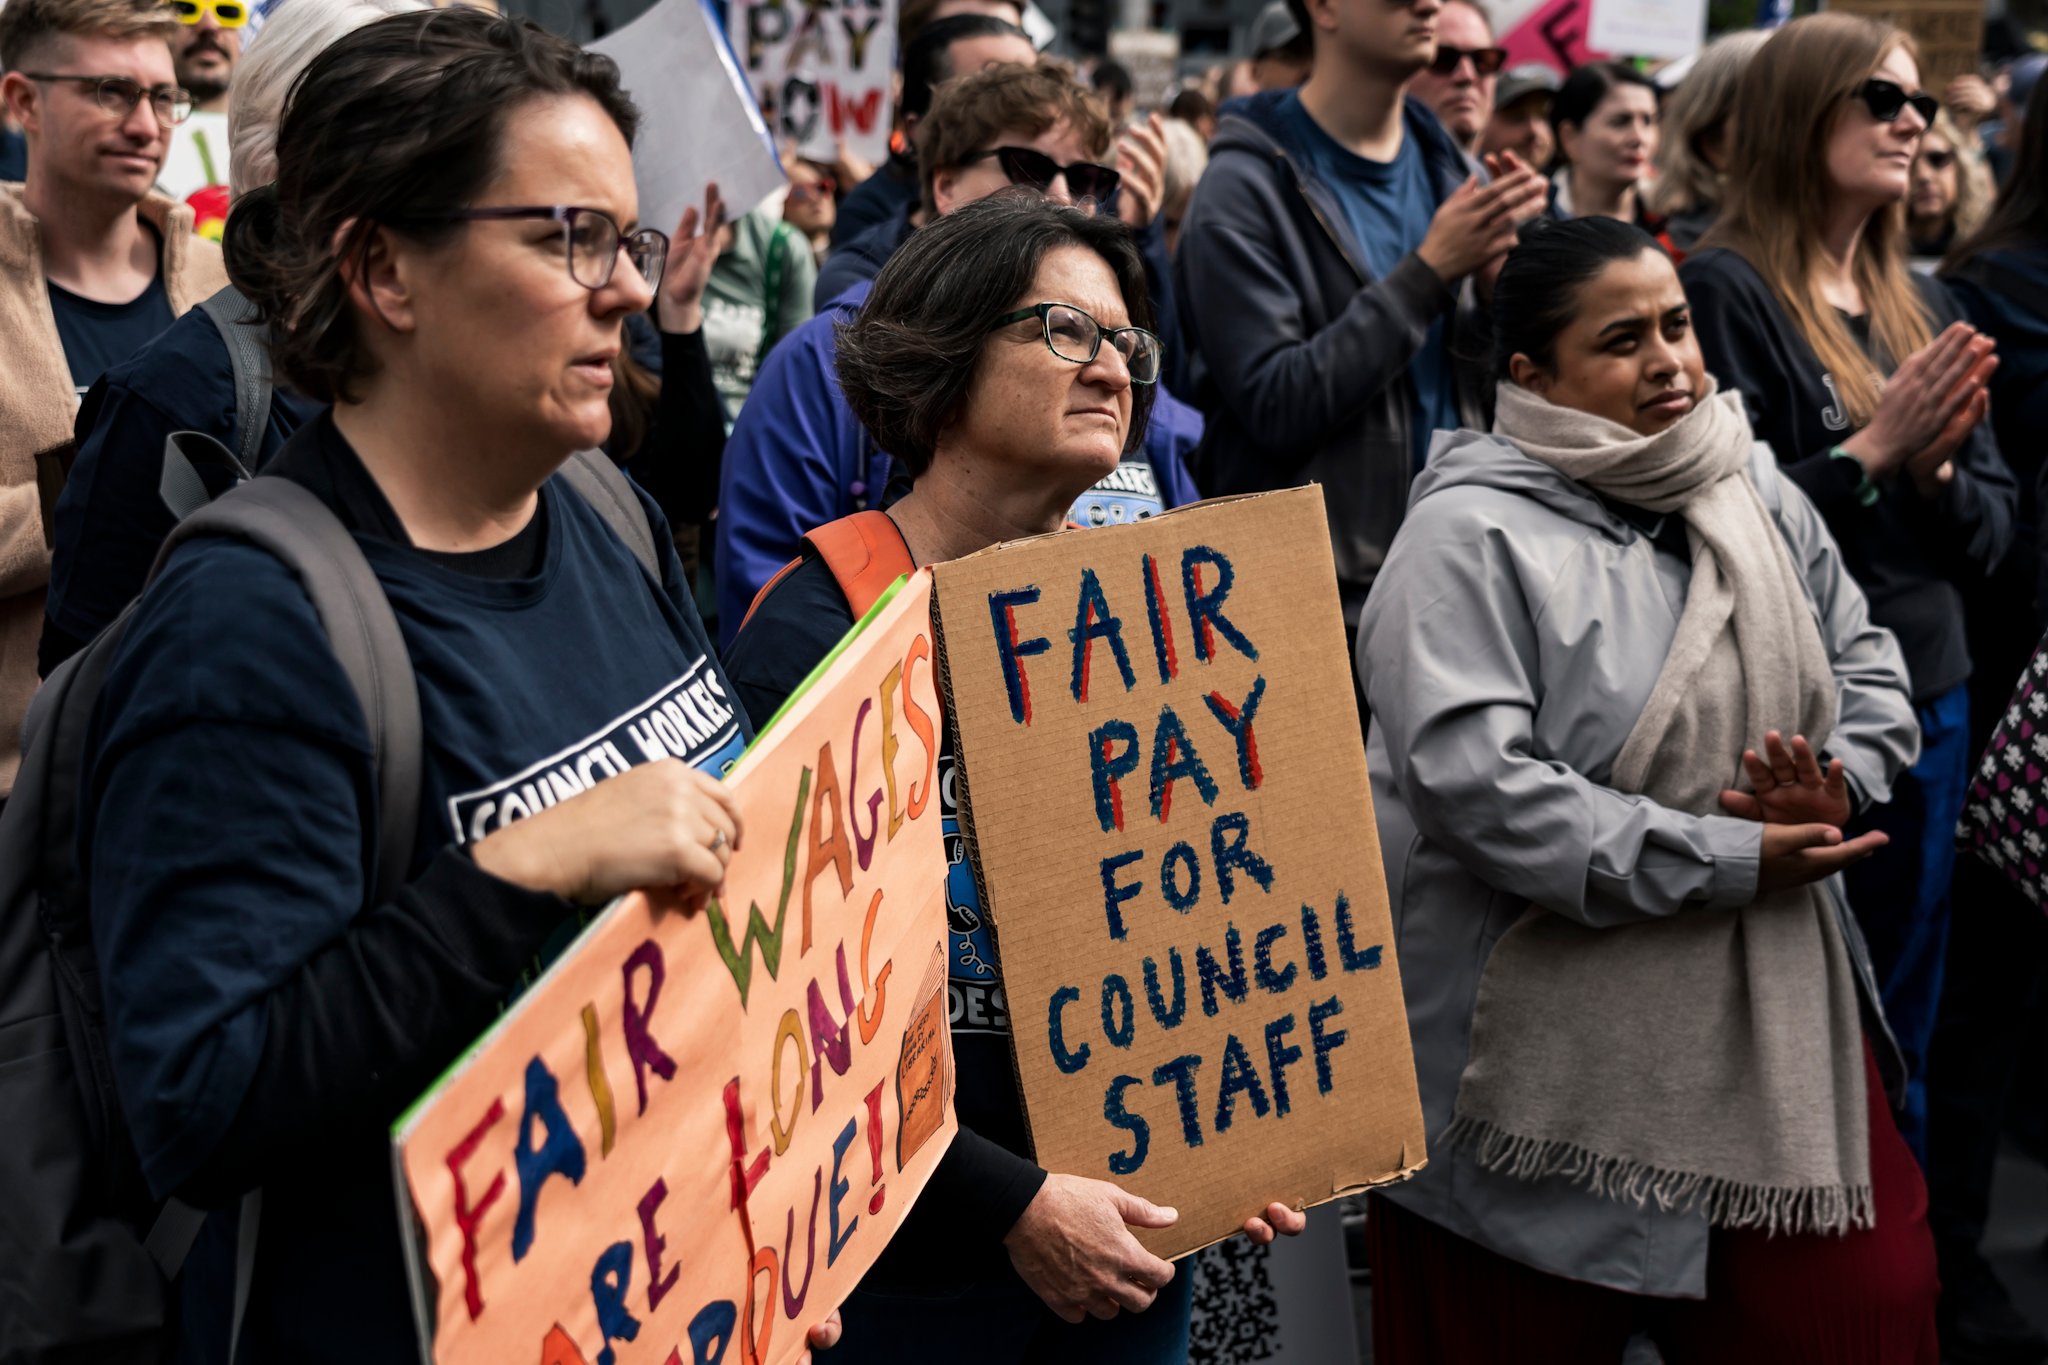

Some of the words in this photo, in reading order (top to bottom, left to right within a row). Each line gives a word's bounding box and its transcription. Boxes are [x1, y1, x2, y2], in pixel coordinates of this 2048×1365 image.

[748, 4, 880, 70] PAY
[989, 545, 1261, 726] FAIR
[1089, 675, 1266, 831] PAY
[1100, 811, 1274, 940] FOR
[446, 939, 677, 1321] FAIR
[708, 634, 934, 1012] WAGES
[723, 889, 891, 1212] LONG
[1049, 889, 1384, 1074] COUNCIL
[1105, 996, 1350, 1175] STAFF
